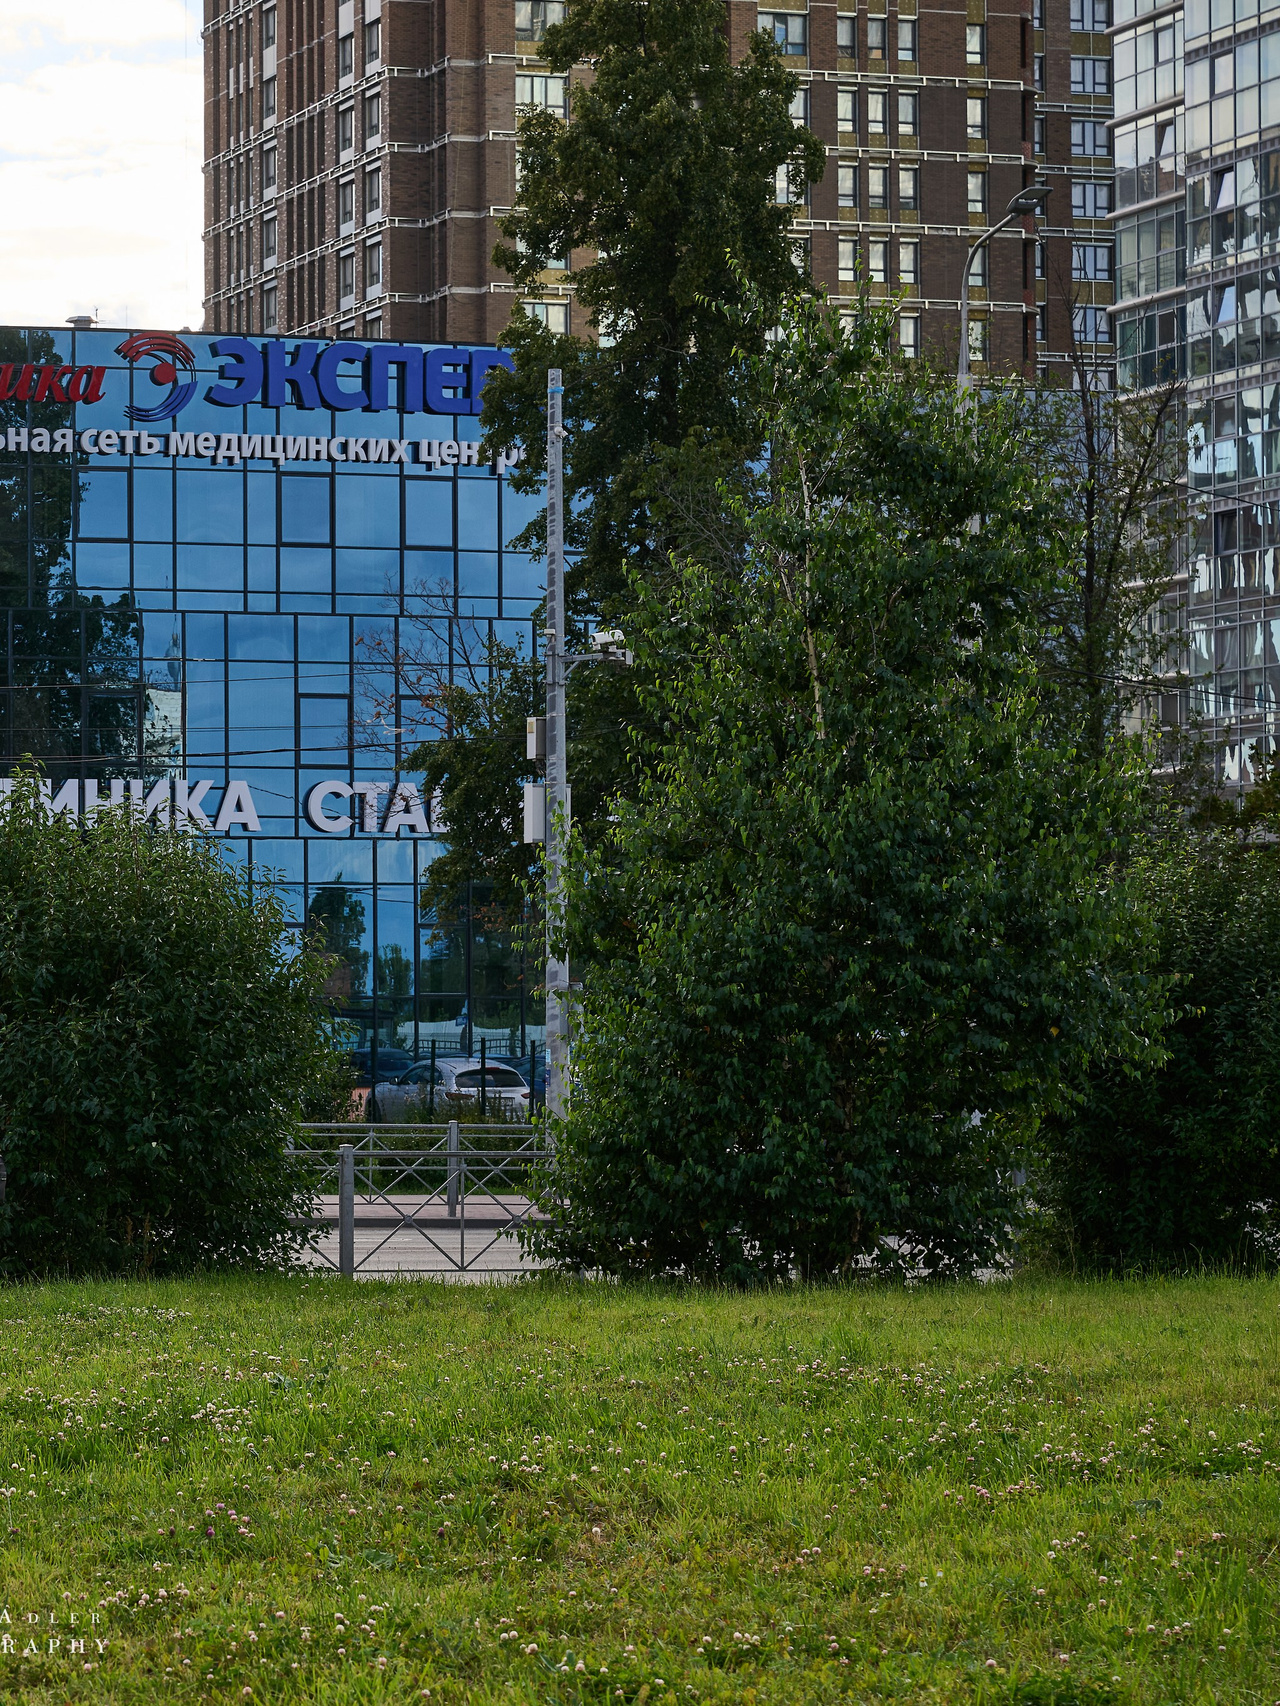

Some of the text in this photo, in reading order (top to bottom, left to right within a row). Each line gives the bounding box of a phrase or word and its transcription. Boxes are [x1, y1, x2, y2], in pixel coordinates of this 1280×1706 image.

[204, 338, 517, 415] ЭКСПЕР
[81, 428, 158, 456] сеть
[169, 431, 410, 464] медицинских
